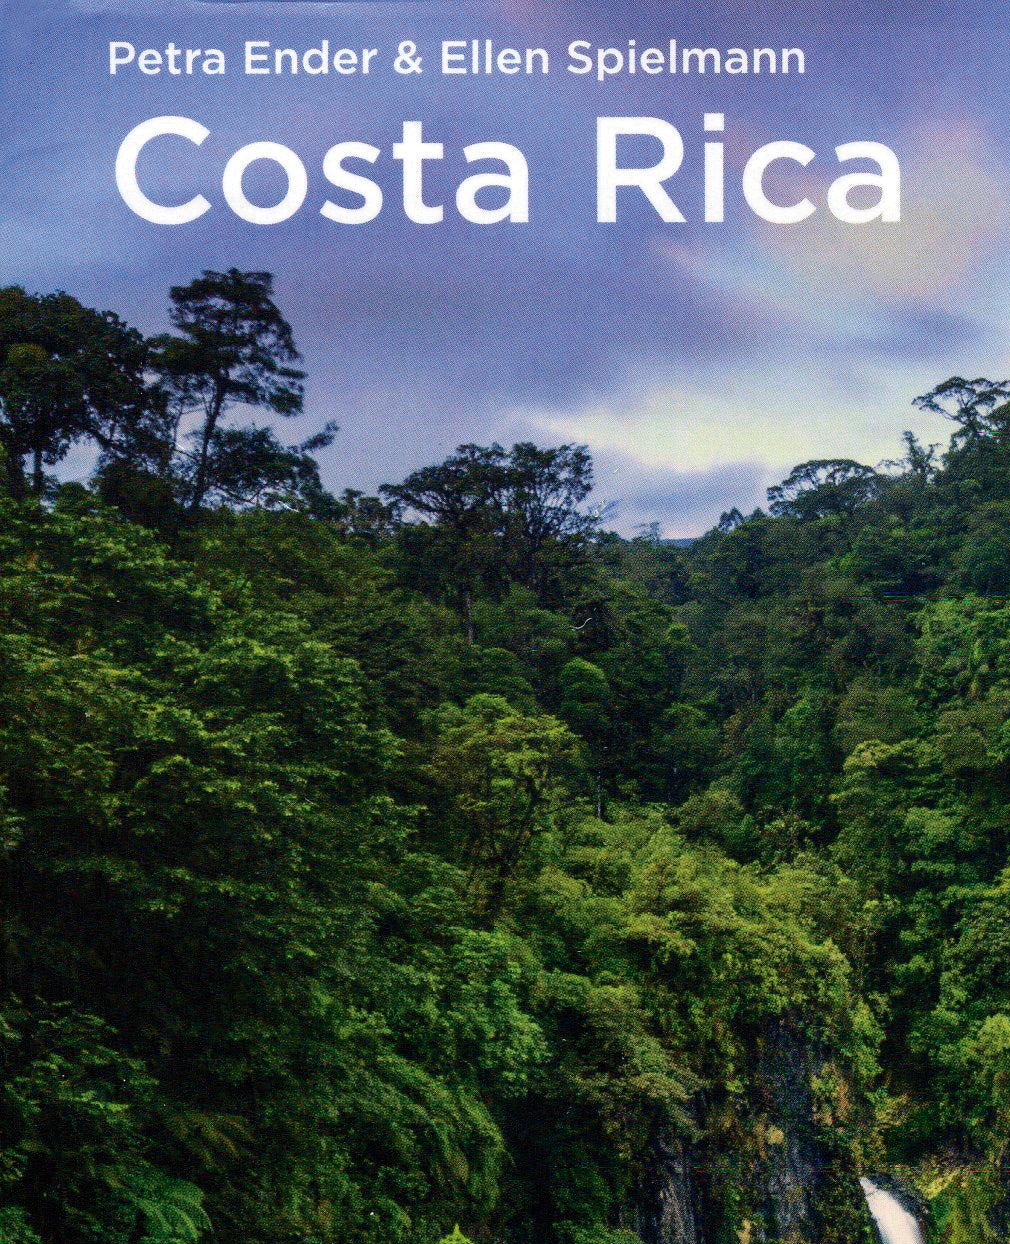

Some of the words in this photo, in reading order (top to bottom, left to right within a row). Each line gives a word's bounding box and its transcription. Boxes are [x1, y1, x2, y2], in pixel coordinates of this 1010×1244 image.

[109, 41, 225, 75] Petra
[244, 40, 378, 75] Ender
[393, 40, 423, 75] &
[441, 39, 549, 75] Ellen
[567, 39, 806, 81] Spielmann
[115, 115, 529, 225] Costa
[596, 112, 902, 224] Rica
